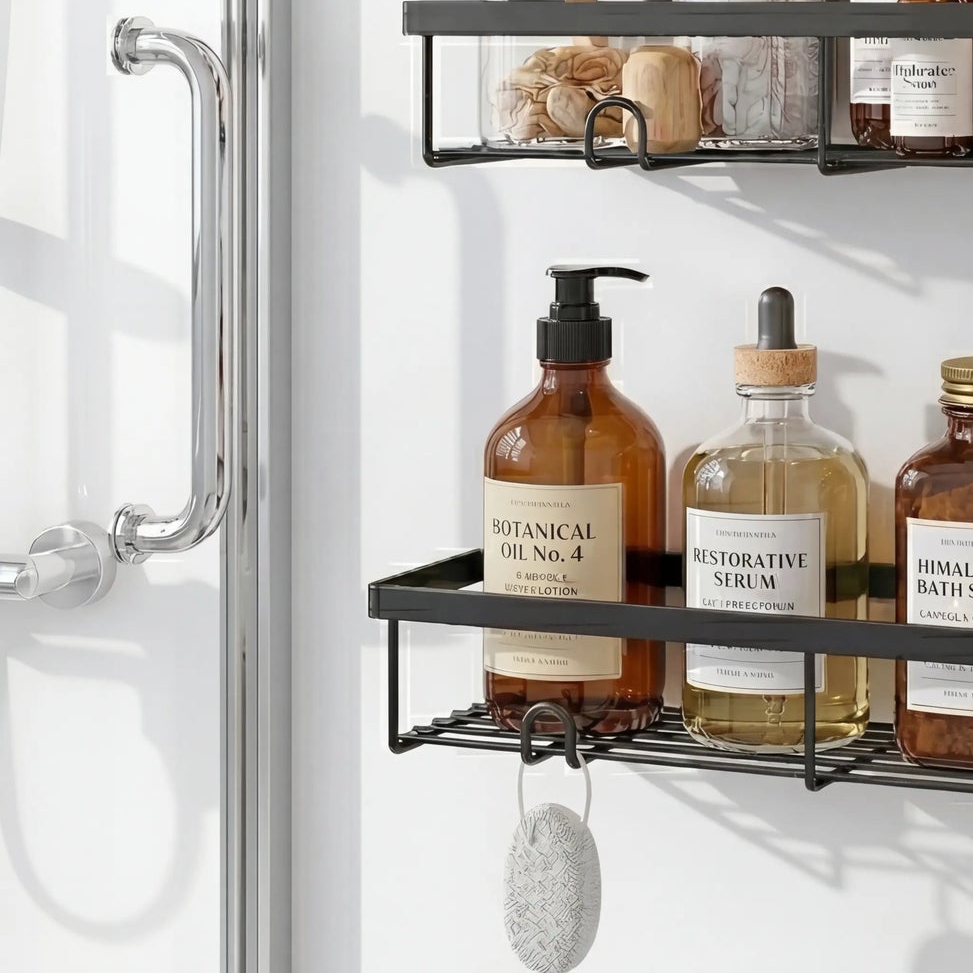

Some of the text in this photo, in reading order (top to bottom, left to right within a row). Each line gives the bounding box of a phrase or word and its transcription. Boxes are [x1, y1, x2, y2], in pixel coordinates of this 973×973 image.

[492, 518, 597, 540] BOTANICAL
[501, 542, 584, 563] OIL No. 4
[693, 548, 808, 569] RESTORATIVE
[714, 571, 776, 590] SERUM
[917, 579, 962, 598] BATH
[538, 586, 578, 596] LOTION
